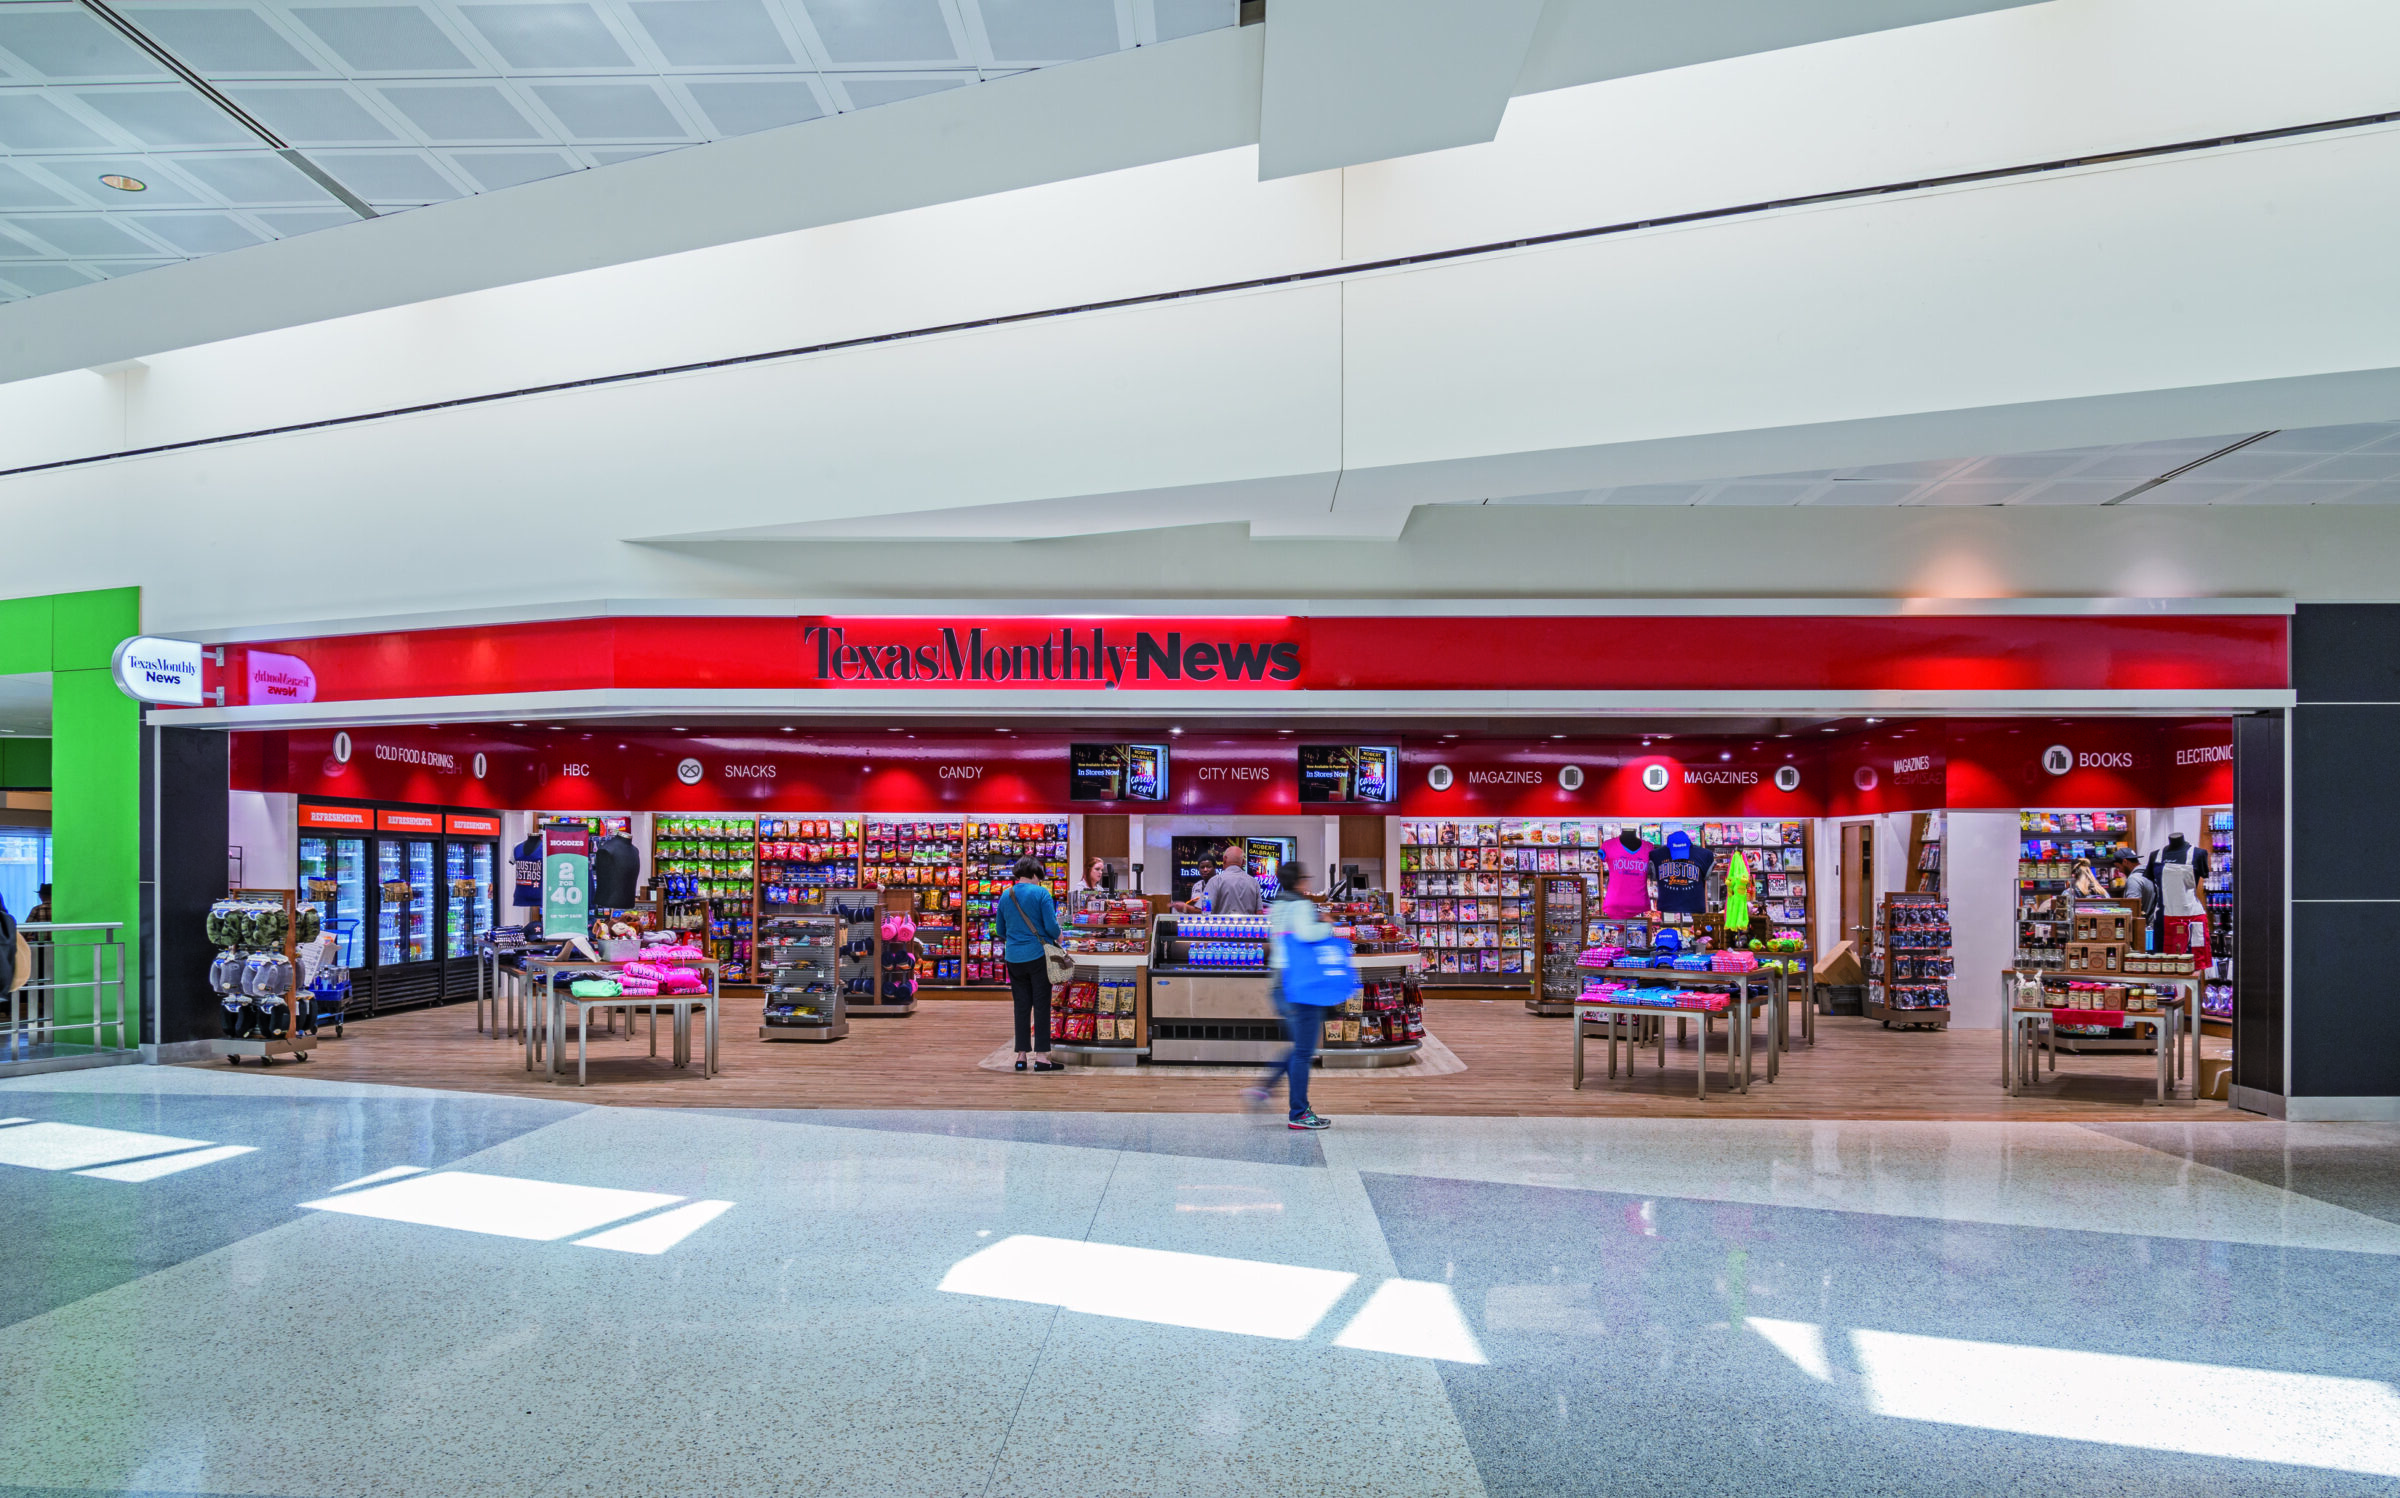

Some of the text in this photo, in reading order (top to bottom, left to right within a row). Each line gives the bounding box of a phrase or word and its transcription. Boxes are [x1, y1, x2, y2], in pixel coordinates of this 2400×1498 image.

[1136, 631, 1300, 681] News
[145, 671, 181, 685] News
[375, 744, 454, 769] COLD FOOD & DRINKS
[2078, 752, 2133, 768] BOOKS
[563, 763, 590, 777] HBC
[724, 764, 777, 779] SNACKS
[1893, 755, 1930, 774] MAGAZINES
[938, 765, 984, 780] CANDY
[1198, 766, 1270, 780] CITY NEWS
[1468, 770, 1543, 785] MAGAZINES
[1684, 770, 1759, 785] MAGAZINES
[558, 862, 574, 880] 2
[1181, 868, 1189, 876] In
[1658, 861, 1700, 882] HOUSTON
